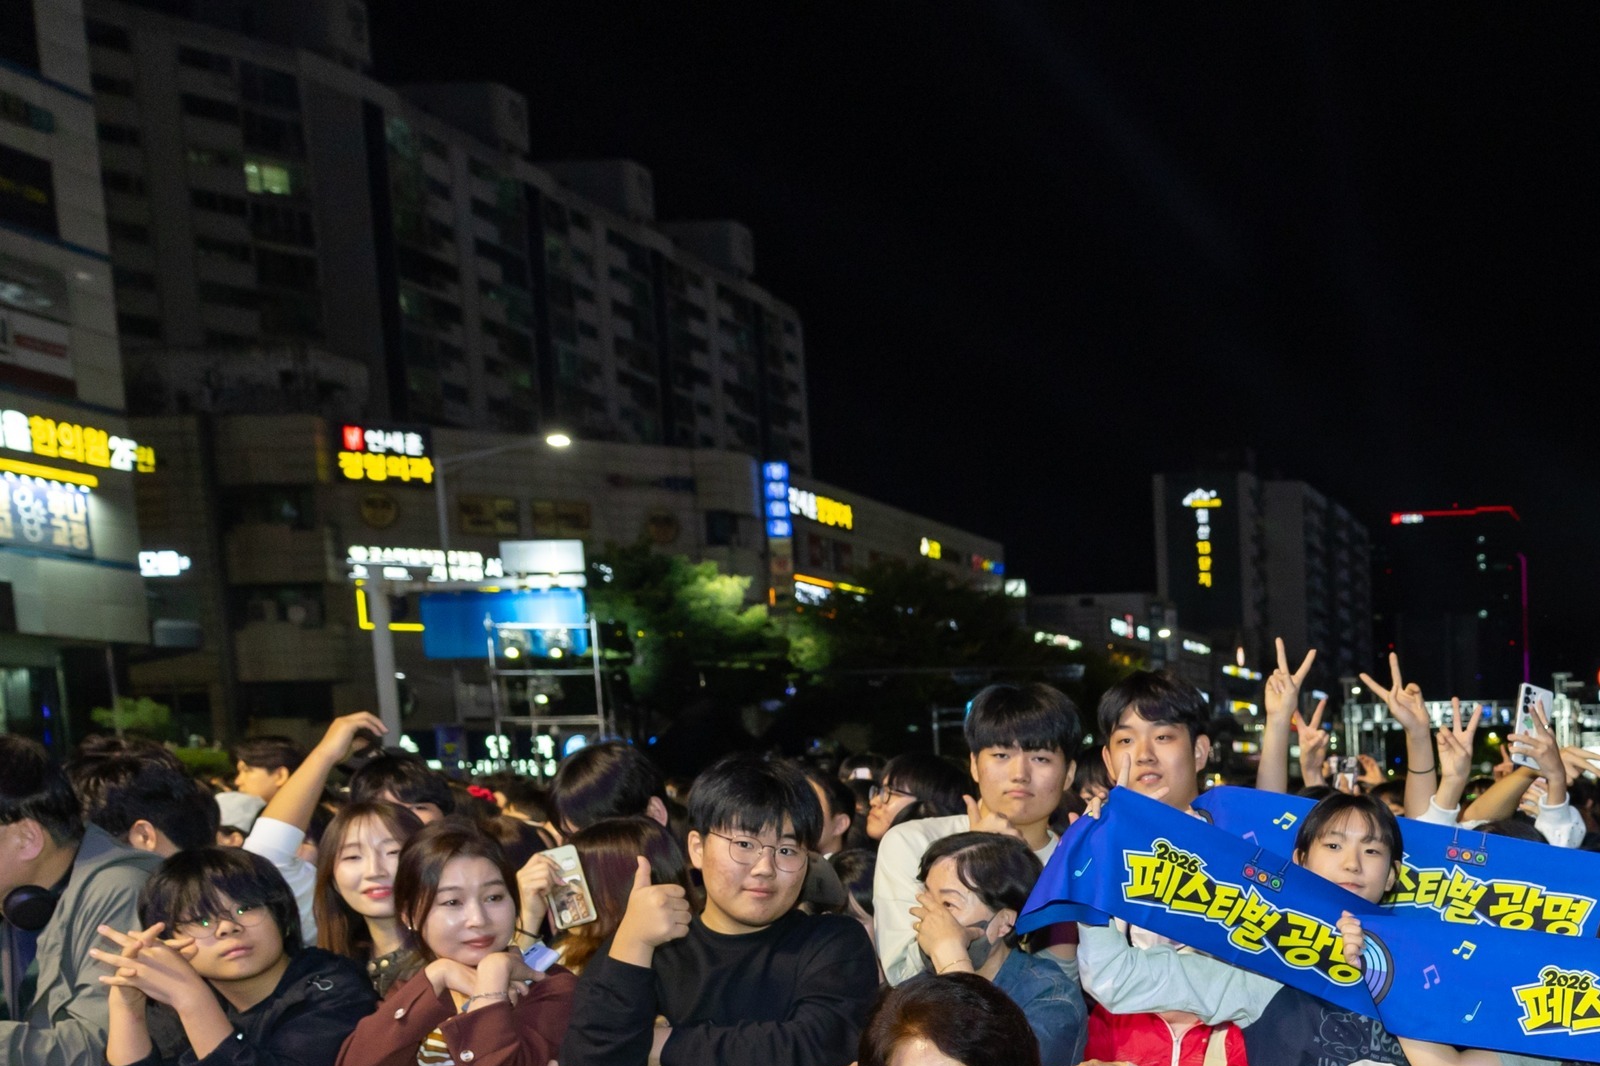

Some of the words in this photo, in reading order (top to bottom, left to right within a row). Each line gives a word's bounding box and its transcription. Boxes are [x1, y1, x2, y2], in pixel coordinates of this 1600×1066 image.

[1156, 842, 1200, 874] 2026
[1125, 853, 1282, 952] 페스티벌
[1393, 863, 1489, 925] 스티벌
[1489, 882, 1592, 937] 광명
[1543, 970, 1591, 991] 2026
